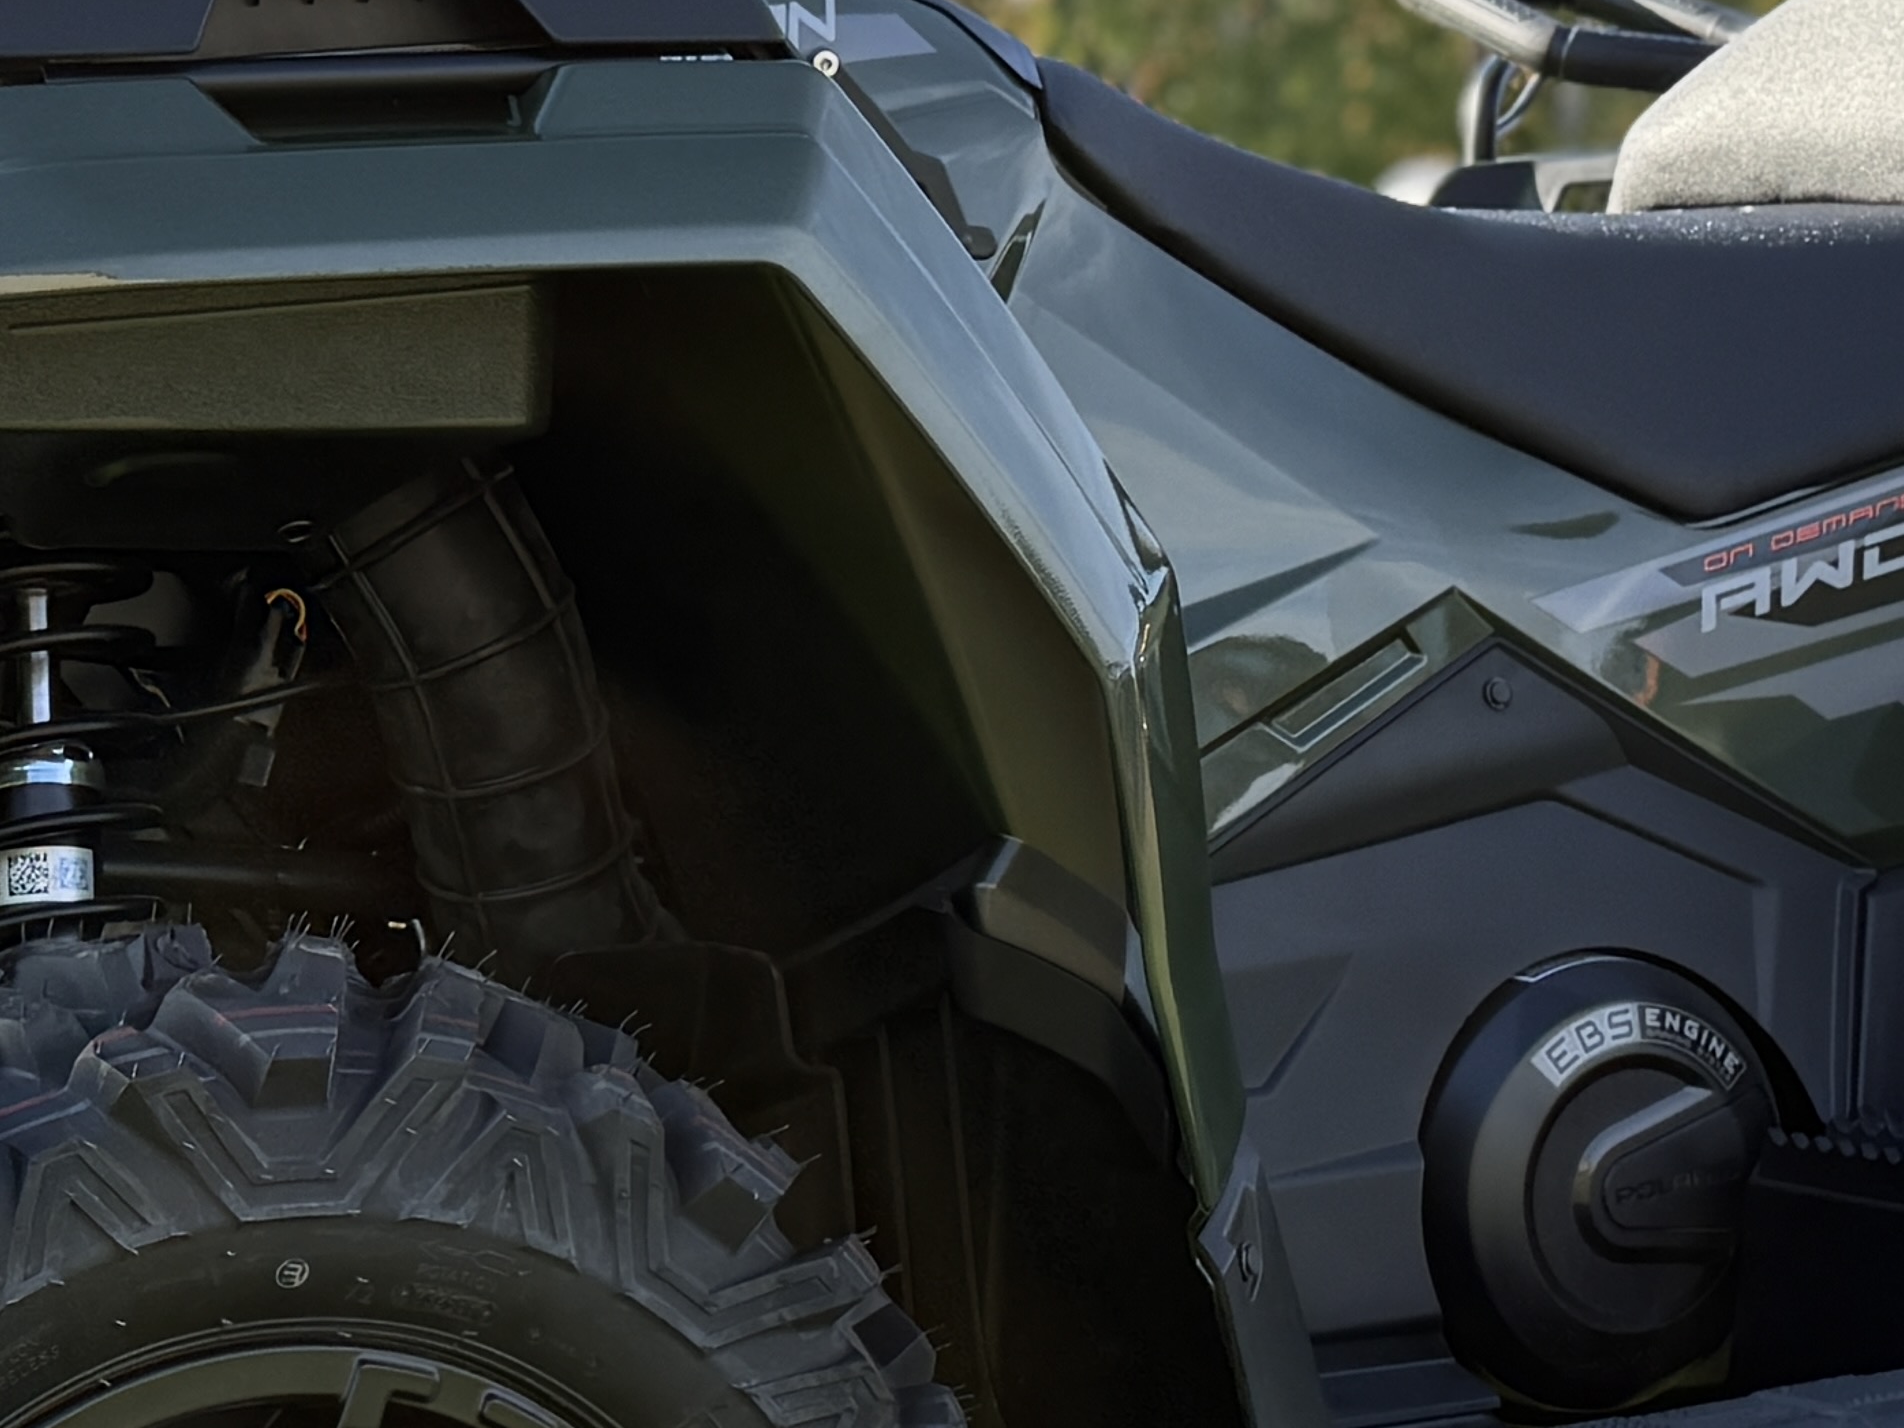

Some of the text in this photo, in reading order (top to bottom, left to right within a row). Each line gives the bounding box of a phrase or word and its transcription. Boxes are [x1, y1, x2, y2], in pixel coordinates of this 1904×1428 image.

[1703, 542, 1753, 573] ON
[1545, 1009, 1633, 1074] EBS
[1645, 1008, 1739, 1076] ENGINE
